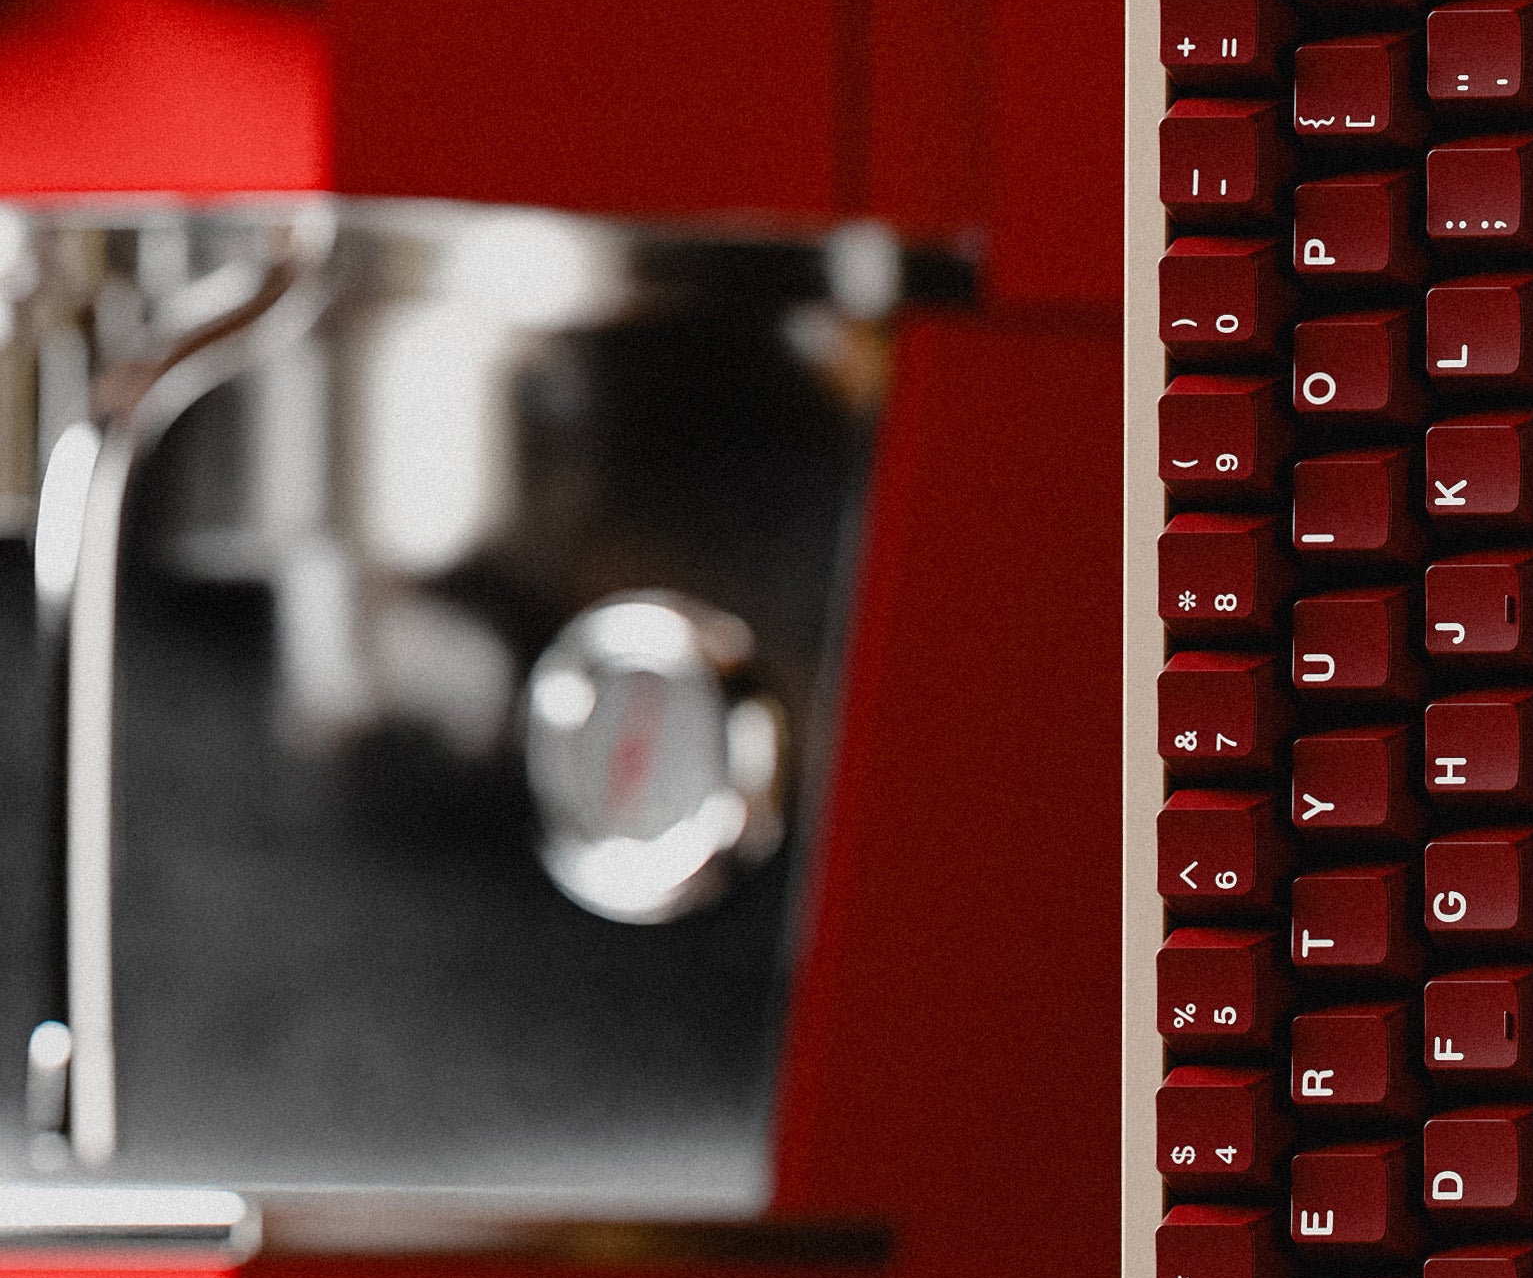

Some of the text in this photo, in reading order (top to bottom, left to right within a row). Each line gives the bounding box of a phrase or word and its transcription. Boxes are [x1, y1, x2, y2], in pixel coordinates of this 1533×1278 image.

[1176, 37, 1196, 58] +
[1221, 38, 1237, 58] =
[1303, 238, 1336, 266] P
[1215, 314, 1239, 334] 0
[1436, 344, 1468, 369] L
[1302, 371, 1337, 405] O
[1215, 453, 1239, 472] 9
[1434, 479, 1468, 506] K
[1214, 593, 1238, 612] 8
[1434, 622, 1466, 645] J
[1301, 653, 1336, 682] U
[1174, 730, 1198, 752] &
[1215, 732, 1238, 752] 7
[1434, 757, 1467, 785] H
[1301, 793, 1335, 821] Y
[1179, 860, 1199, 890] ^
[1214, 870, 1238, 890] 6
[1432, 890, 1467, 923] G
[1301, 929, 1335, 958] T
[1173, 1003, 1197, 1029] %
[1213, 1006, 1237, 1025] 5
[1433, 1036, 1465, 1061] F
[1301, 1069, 1334, 1097] R
[1170, 1145, 1196, 1165] $
[1214, 1145, 1238, 1165] 4
[1431, 1170, 1464, 1201] D
[1300, 1209, 1334, 1236] E
